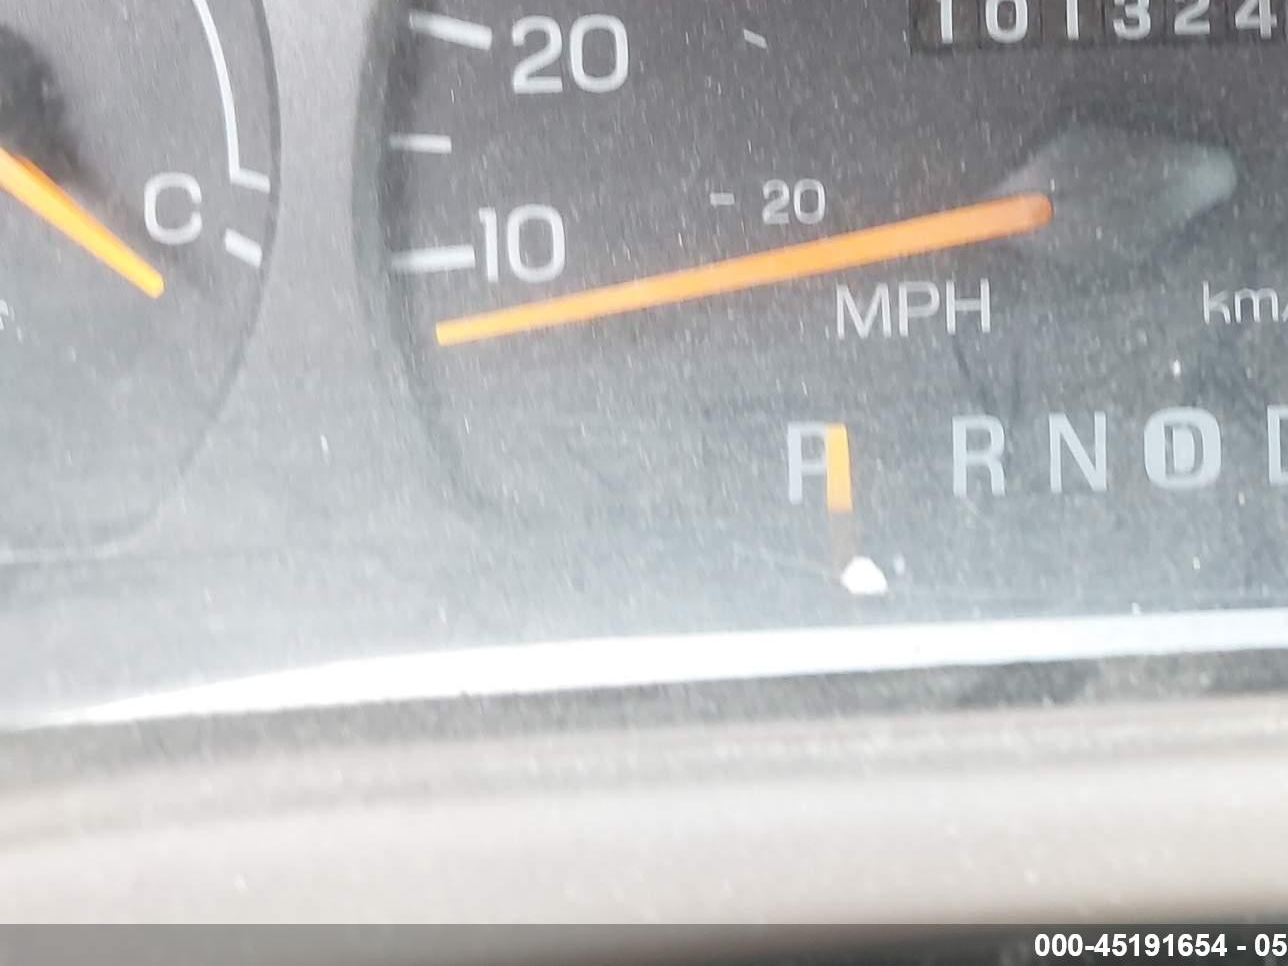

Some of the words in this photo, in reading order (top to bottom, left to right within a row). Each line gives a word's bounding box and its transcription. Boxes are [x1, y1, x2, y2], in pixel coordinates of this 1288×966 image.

[511, 14, 629, 94] 20
[143, 172, 203, 244] C
[761, 178, 826, 226] 20
[478, 205, 566, 283] 10
[836, 279, 991, 341] MPH
[952, 415, 1006, 499] R
[1048, 412, 1109, 494] N
